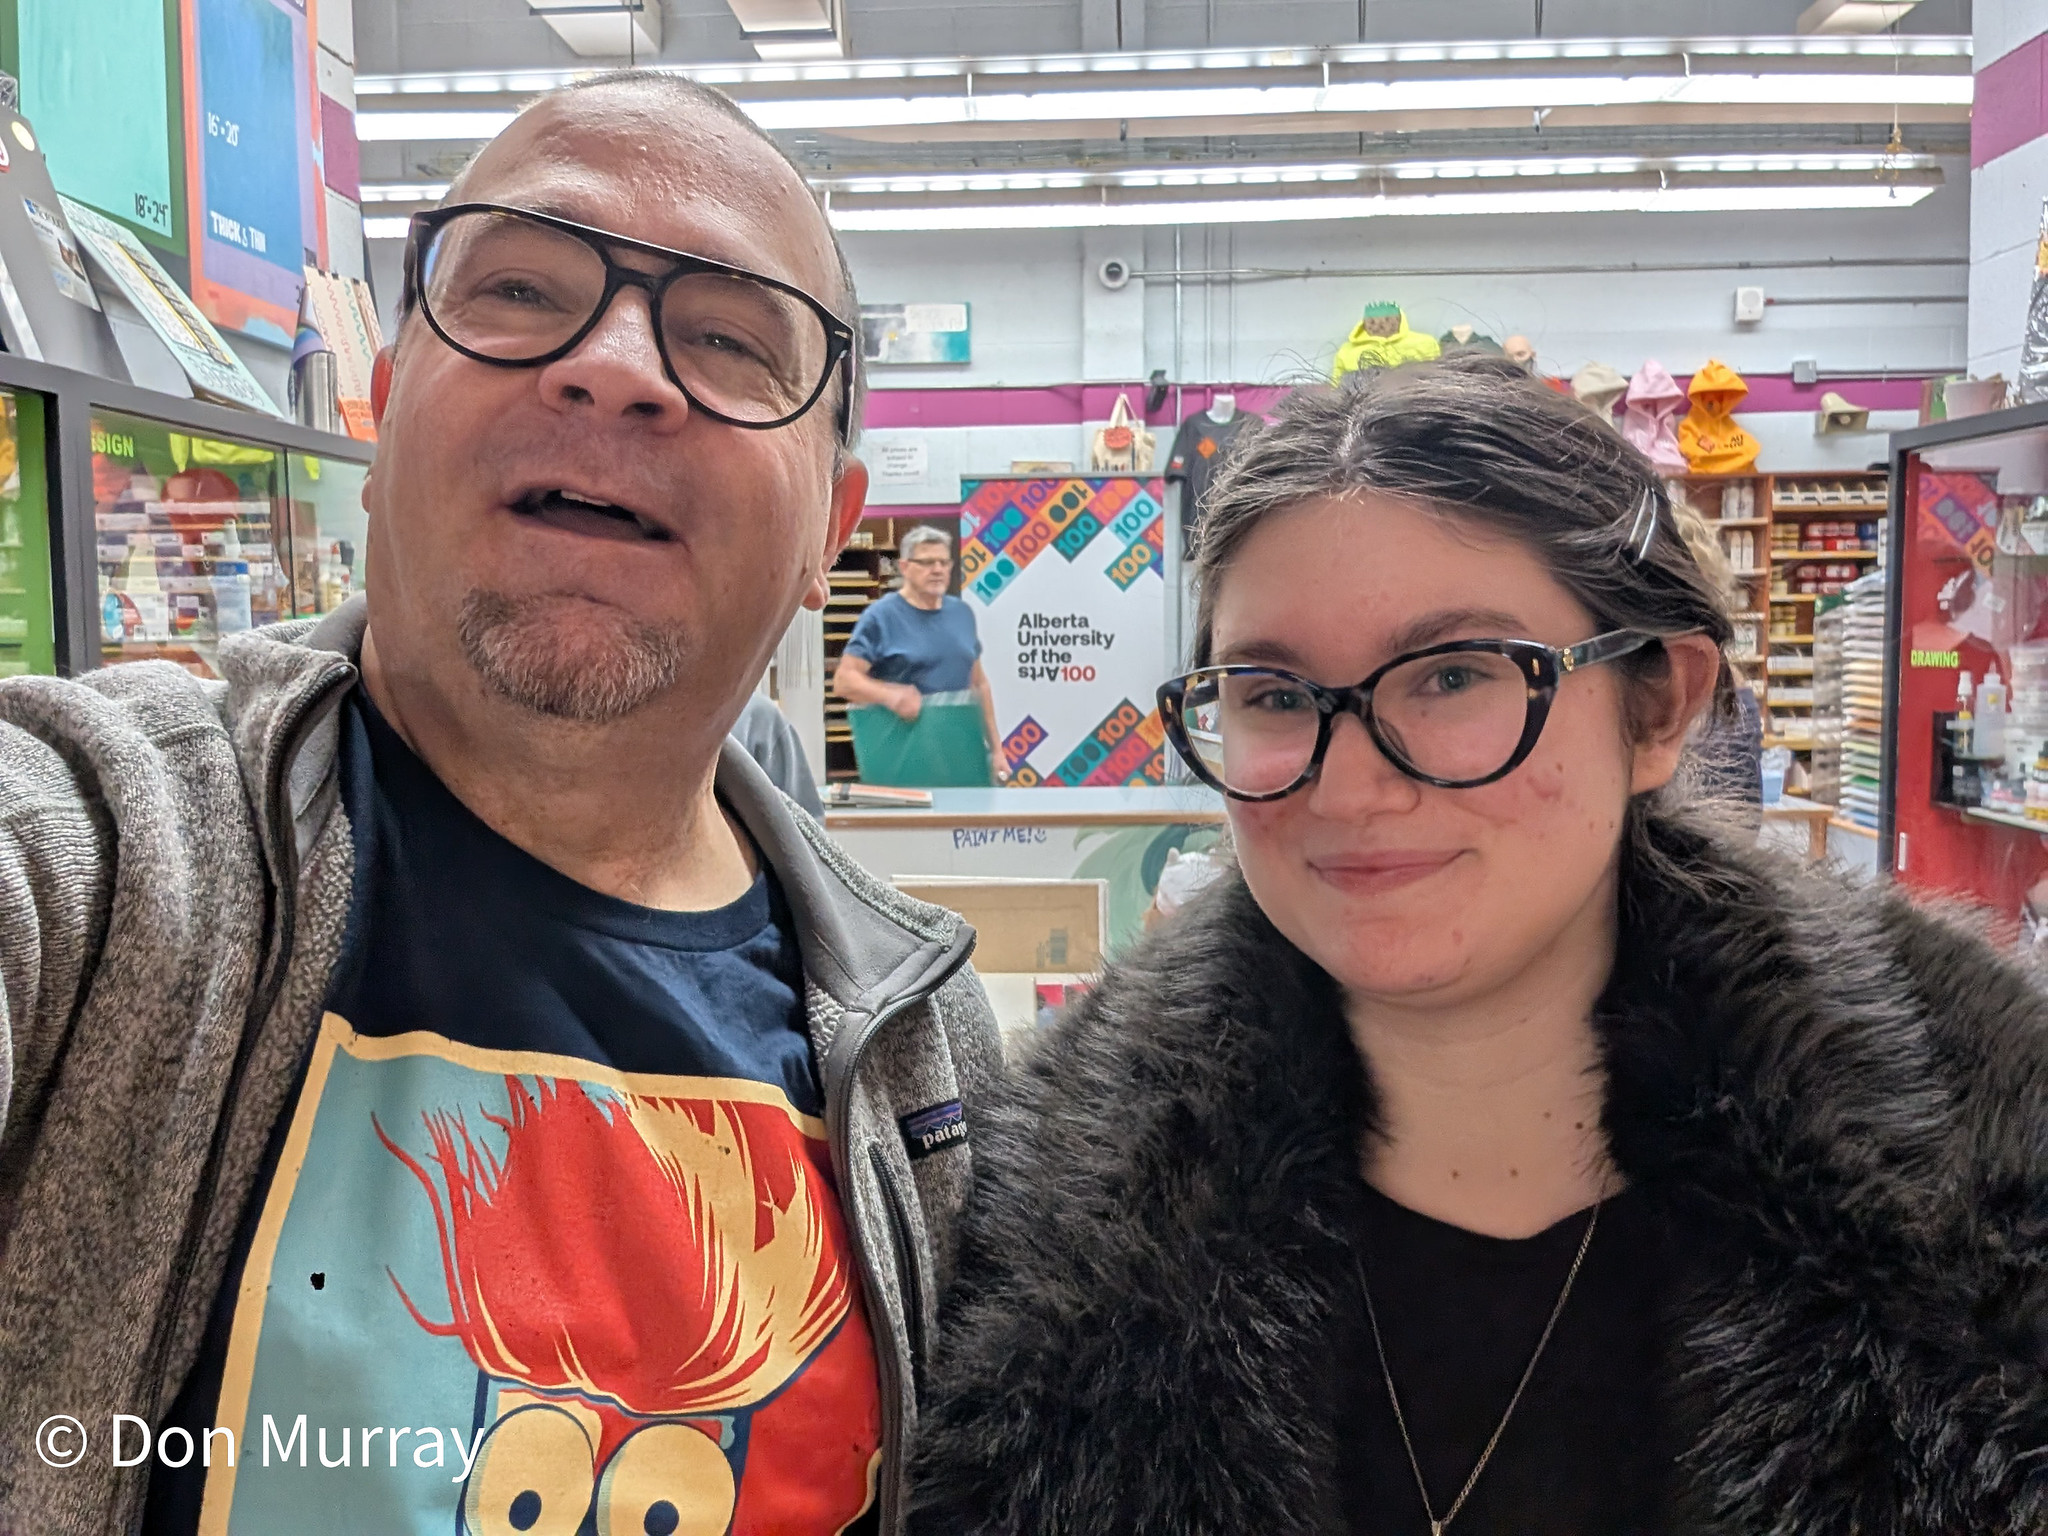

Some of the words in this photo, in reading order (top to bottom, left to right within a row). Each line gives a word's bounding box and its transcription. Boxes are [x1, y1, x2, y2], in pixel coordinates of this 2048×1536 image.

[210, 210, 241, 244] THICK
[1050, 484, 1088, 523] 100
[1115, 499, 1154, 539] 100
[985, 507, 1023, 549] 100
[1012, 521, 1051, 561] 100
[1058, 515, 1098, 555] 100
[977, 559, 1015, 598] 100
[1112, 543, 1151, 584] 100
[1018, 613, 1089, 629] Alberta
[1018, 630, 1115, 650] University
[1018, 649, 1038, 664] of
[1042, 649, 1072, 664] the
[1911, 650, 1959, 668] DRAWING
[1098, 706, 1138, 746] 100
[1063, 743, 1100, 783] 100
[953, 828, 999, 850] PAINT
[1003, 827, 1032, 844] ME!
